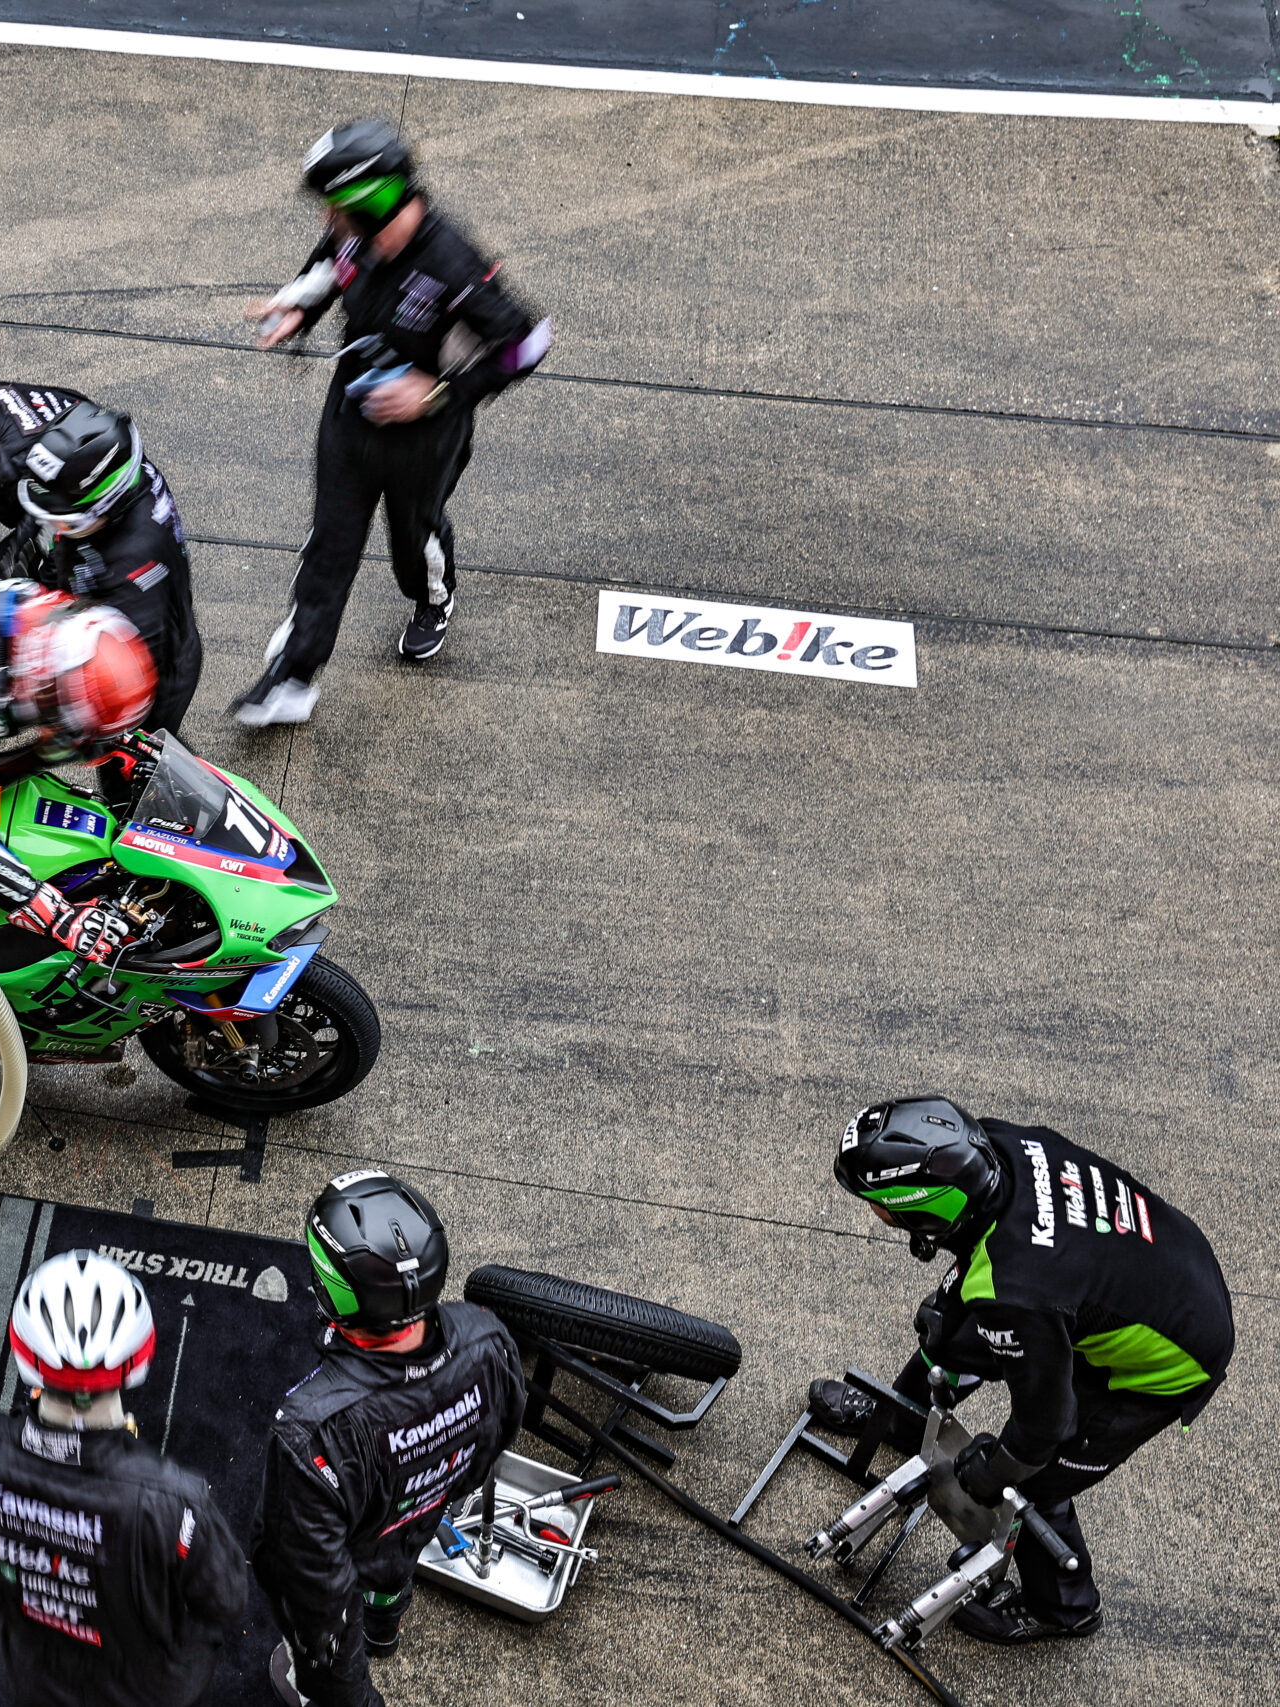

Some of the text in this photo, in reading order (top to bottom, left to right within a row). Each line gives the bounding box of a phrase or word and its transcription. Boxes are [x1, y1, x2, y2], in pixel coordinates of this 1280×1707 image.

[86, 814, 97, 833] KWT
[149, 817, 186, 831] Puig
[132, 835, 176, 856] MOTUL
[220, 858, 246, 873] KWT
[236, 932, 265, 943] TRICK STAR
[217, 954, 254, 966] KWT
[141, 975, 198, 987] Ninja
[262, 954, 301, 1005] Kawasaki
[232, 1011, 255, 1019] MOTUL
[866, 1162, 921, 1183] LS2
[882, 1188, 929, 1205] Kawasaki
[1020, 1138, 1055, 1248] Kawasaki
[165, 1259, 249, 1289] TRICK
[977, 1323, 1014, 1346] KWT
[388, 1384, 482, 1454] Kawasaki
[398, 1412, 480, 1465] Let the good times roll
[1058, 1456, 1109, 1473] Kawasaki
